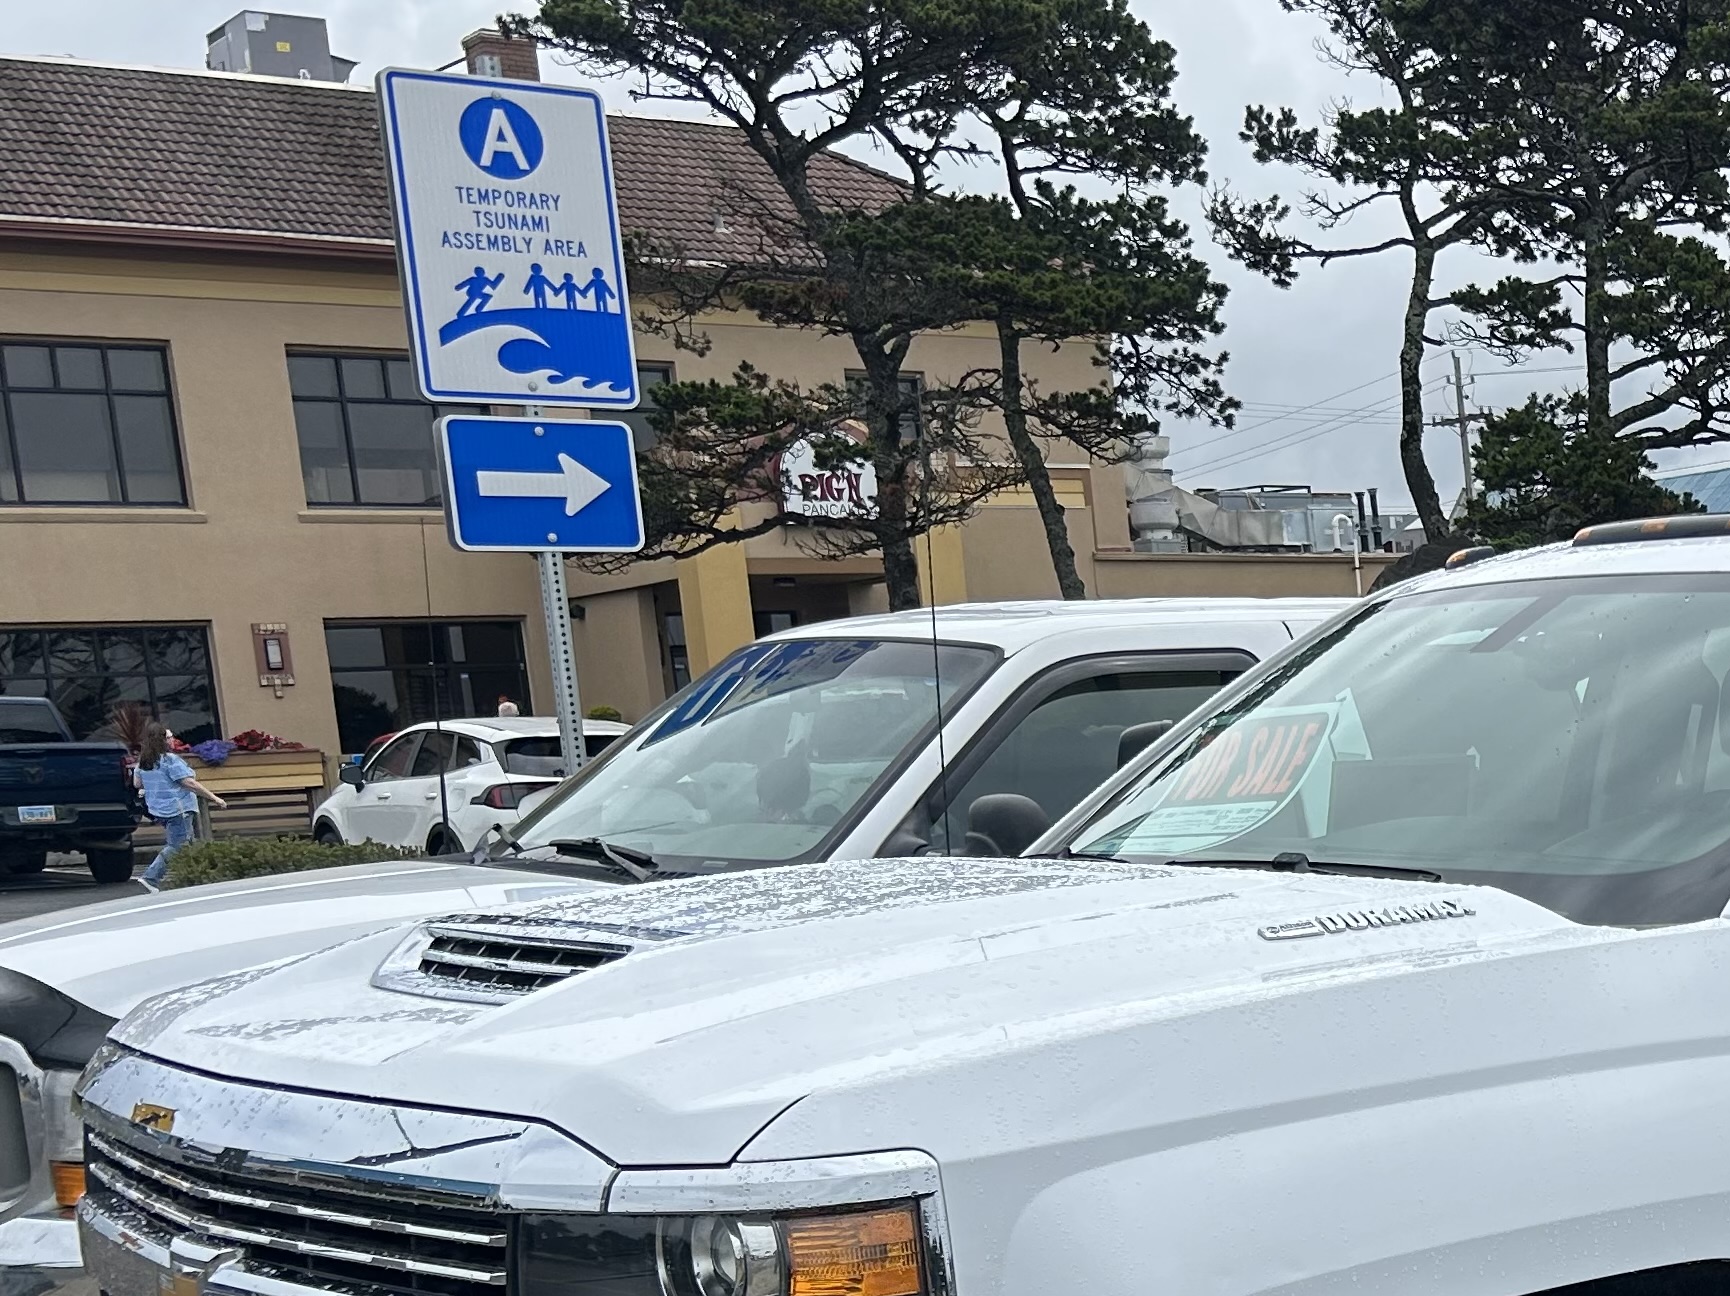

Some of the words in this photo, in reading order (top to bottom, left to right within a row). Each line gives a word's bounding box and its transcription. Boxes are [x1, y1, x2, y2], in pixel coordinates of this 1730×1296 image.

[480, 107, 530, 171] A
[455, 186, 561, 211] TEMPORARY
[473, 210, 550, 233] TSUNAMI
[441, 231, 533, 254] ASSEMBLY
[543, 239, 588, 258] AREA
[1164, 728, 1243, 801] FOR
[1227, 722, 1320, 798] SALE
